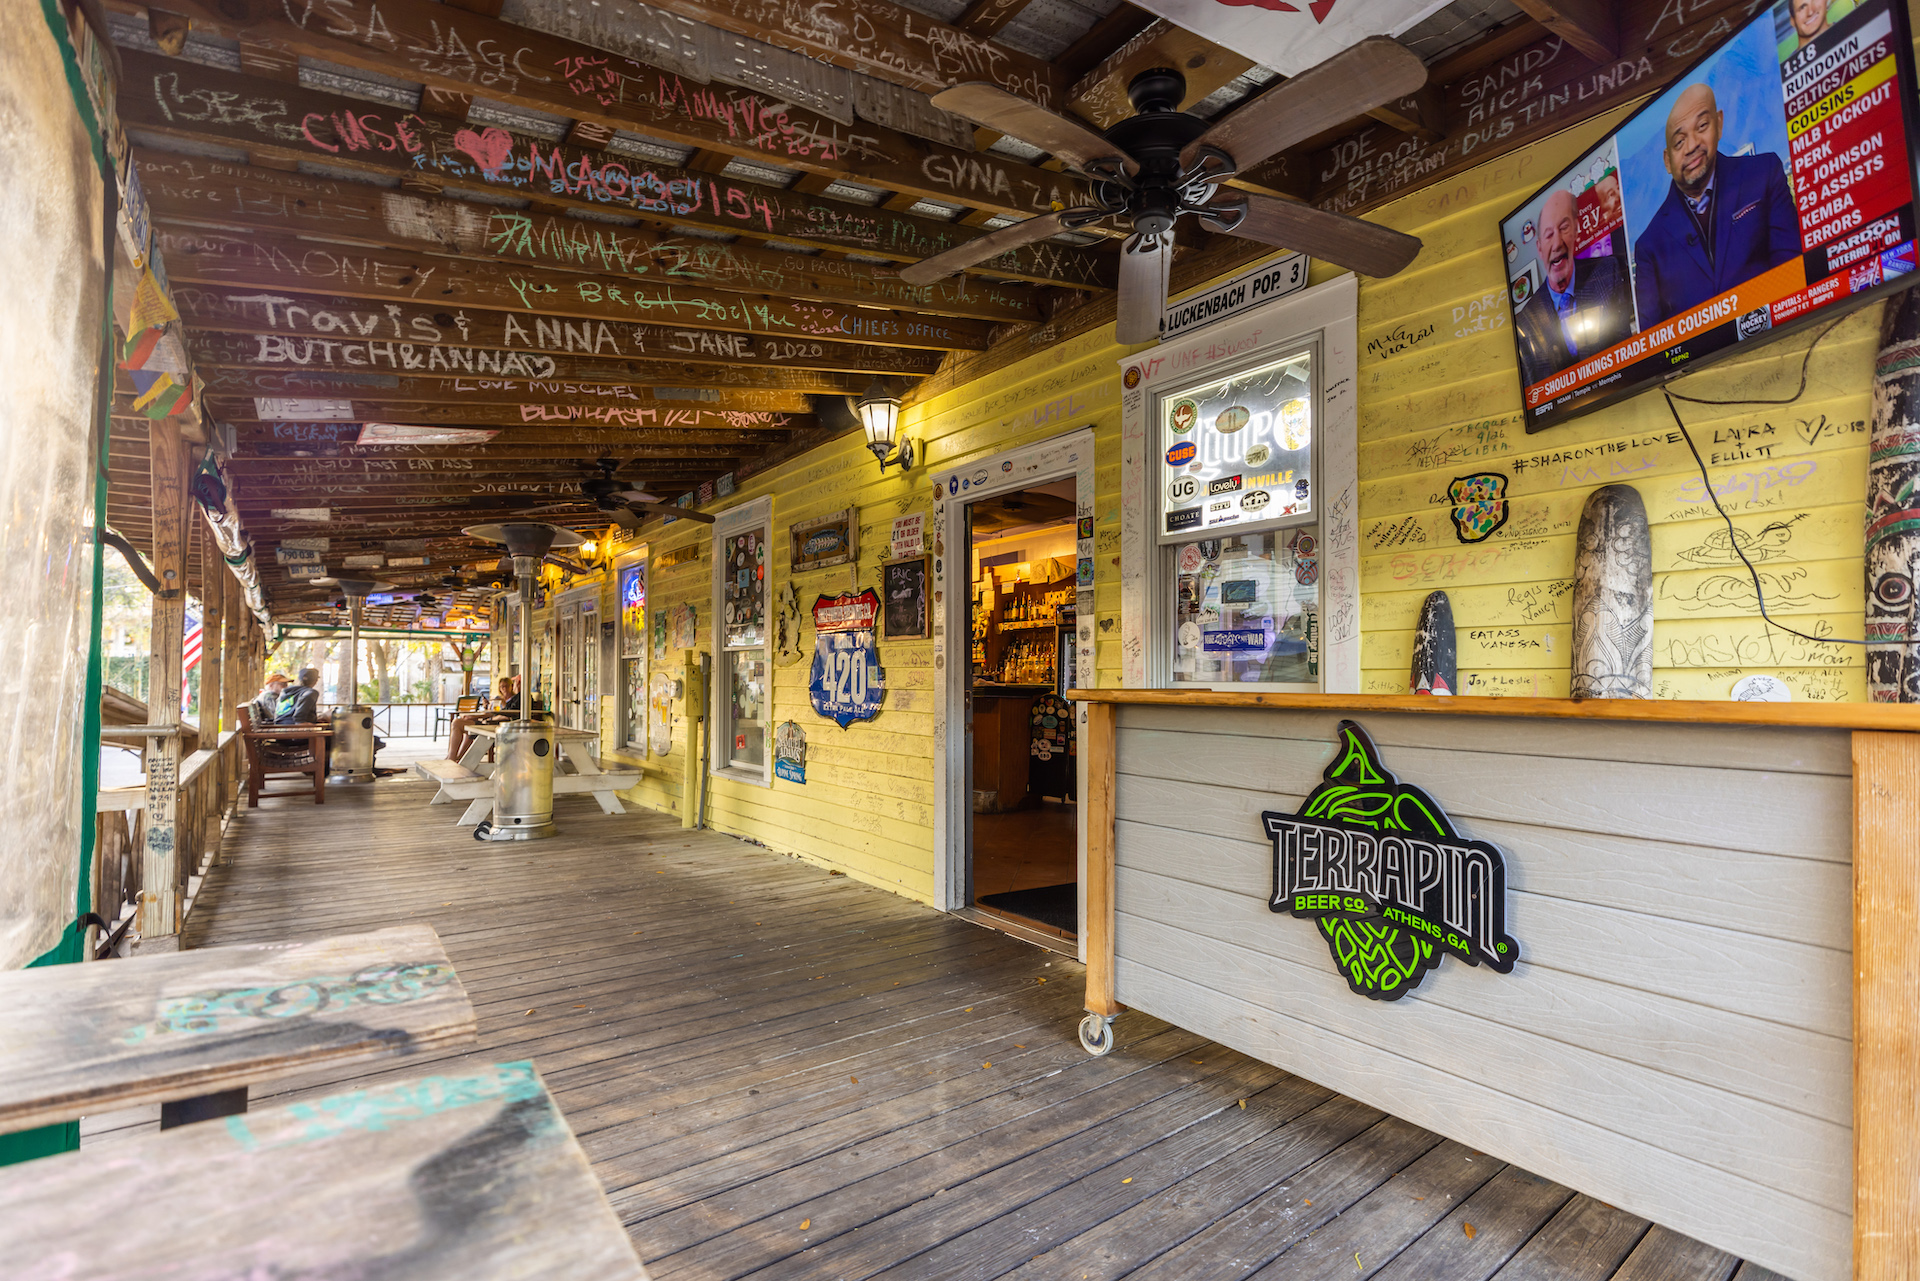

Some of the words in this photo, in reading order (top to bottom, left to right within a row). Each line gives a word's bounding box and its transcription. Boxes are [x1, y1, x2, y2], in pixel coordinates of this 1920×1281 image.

[1784, 43, 1817, 77] 1:18
[1786, 37, 1859, 97] RUNDOWN
[1787, 41, 1887, 116] CELTICS/NETS
[1791, 85, 1855, 134] COUSINS
[1792, 127, 1822, 154] MLB
[1825, 82, 1891, 134] LOCKOUT
[1321, 127, 1376, 182] JOE
[1794, 141, 1833, 173] PERK
[1796, 176, 1810, 193] Z.
[1813, 132, 1884, 185] JOHNSON
[1799, 191, 1817, 212] 29
[1821, 155, 1885, 200] ASSISTS
[1802, 193, 1855, 229] KEMBA
[1803, 209, 1863, 249] ERRORS
[1826, 215, 1900, 258] PARDON
[1168, 284, 1247, 331] LUCKENBACH
[1252, 270, 1281, 298] POP.
[1290, 263, 1300, 283] 3
[1772, 294, 1802, 313] CAPITALS
[1808, 278, 1840, 298] RANGERS
[226, 294, 442, 343] Travis
[504, 313, 622, 355] ANNA
[766, 341, 824, 360] 2020
[906, 323, 953, 340] OFFICE
[1740, 313, 1767, 331] HOCKEY
[1544, 370, 1577, 396] SHOULD
[1577, 353, 1614, 381] VIKINGS
[1613, 337, 1648, 364] TRADE
[1649, 324, 1676, 349] KIRK
[1677, 294, 1739, 336] COUSINS?
[1671, 352, 1689, 364] ESPN2
[1675, 346, 1682, 354] ET
[1598, 372, 1622, 387] Memphis
[1168, 445, 1196, 463] CUSE
[1512, 431, 1684, 474] #SHARONTHELOVE
[1172, 481, 1195, 498] UG
[1210, 479, 1238, 494] Lovely
[1169, 511, 1200, 523] CHOATE
[1664, 506, 1713, 521] THANK
[822, 651, 868, 705] 420
[1267, 818, 1500, 962] TERRAPIN
[1295, 895, 1341, 911] BEER
[1344, 897, 1369, 914] CO.
[1382, 906, 1446, 943] ATHENS,
[1447, 935, 1471, 955] GA
